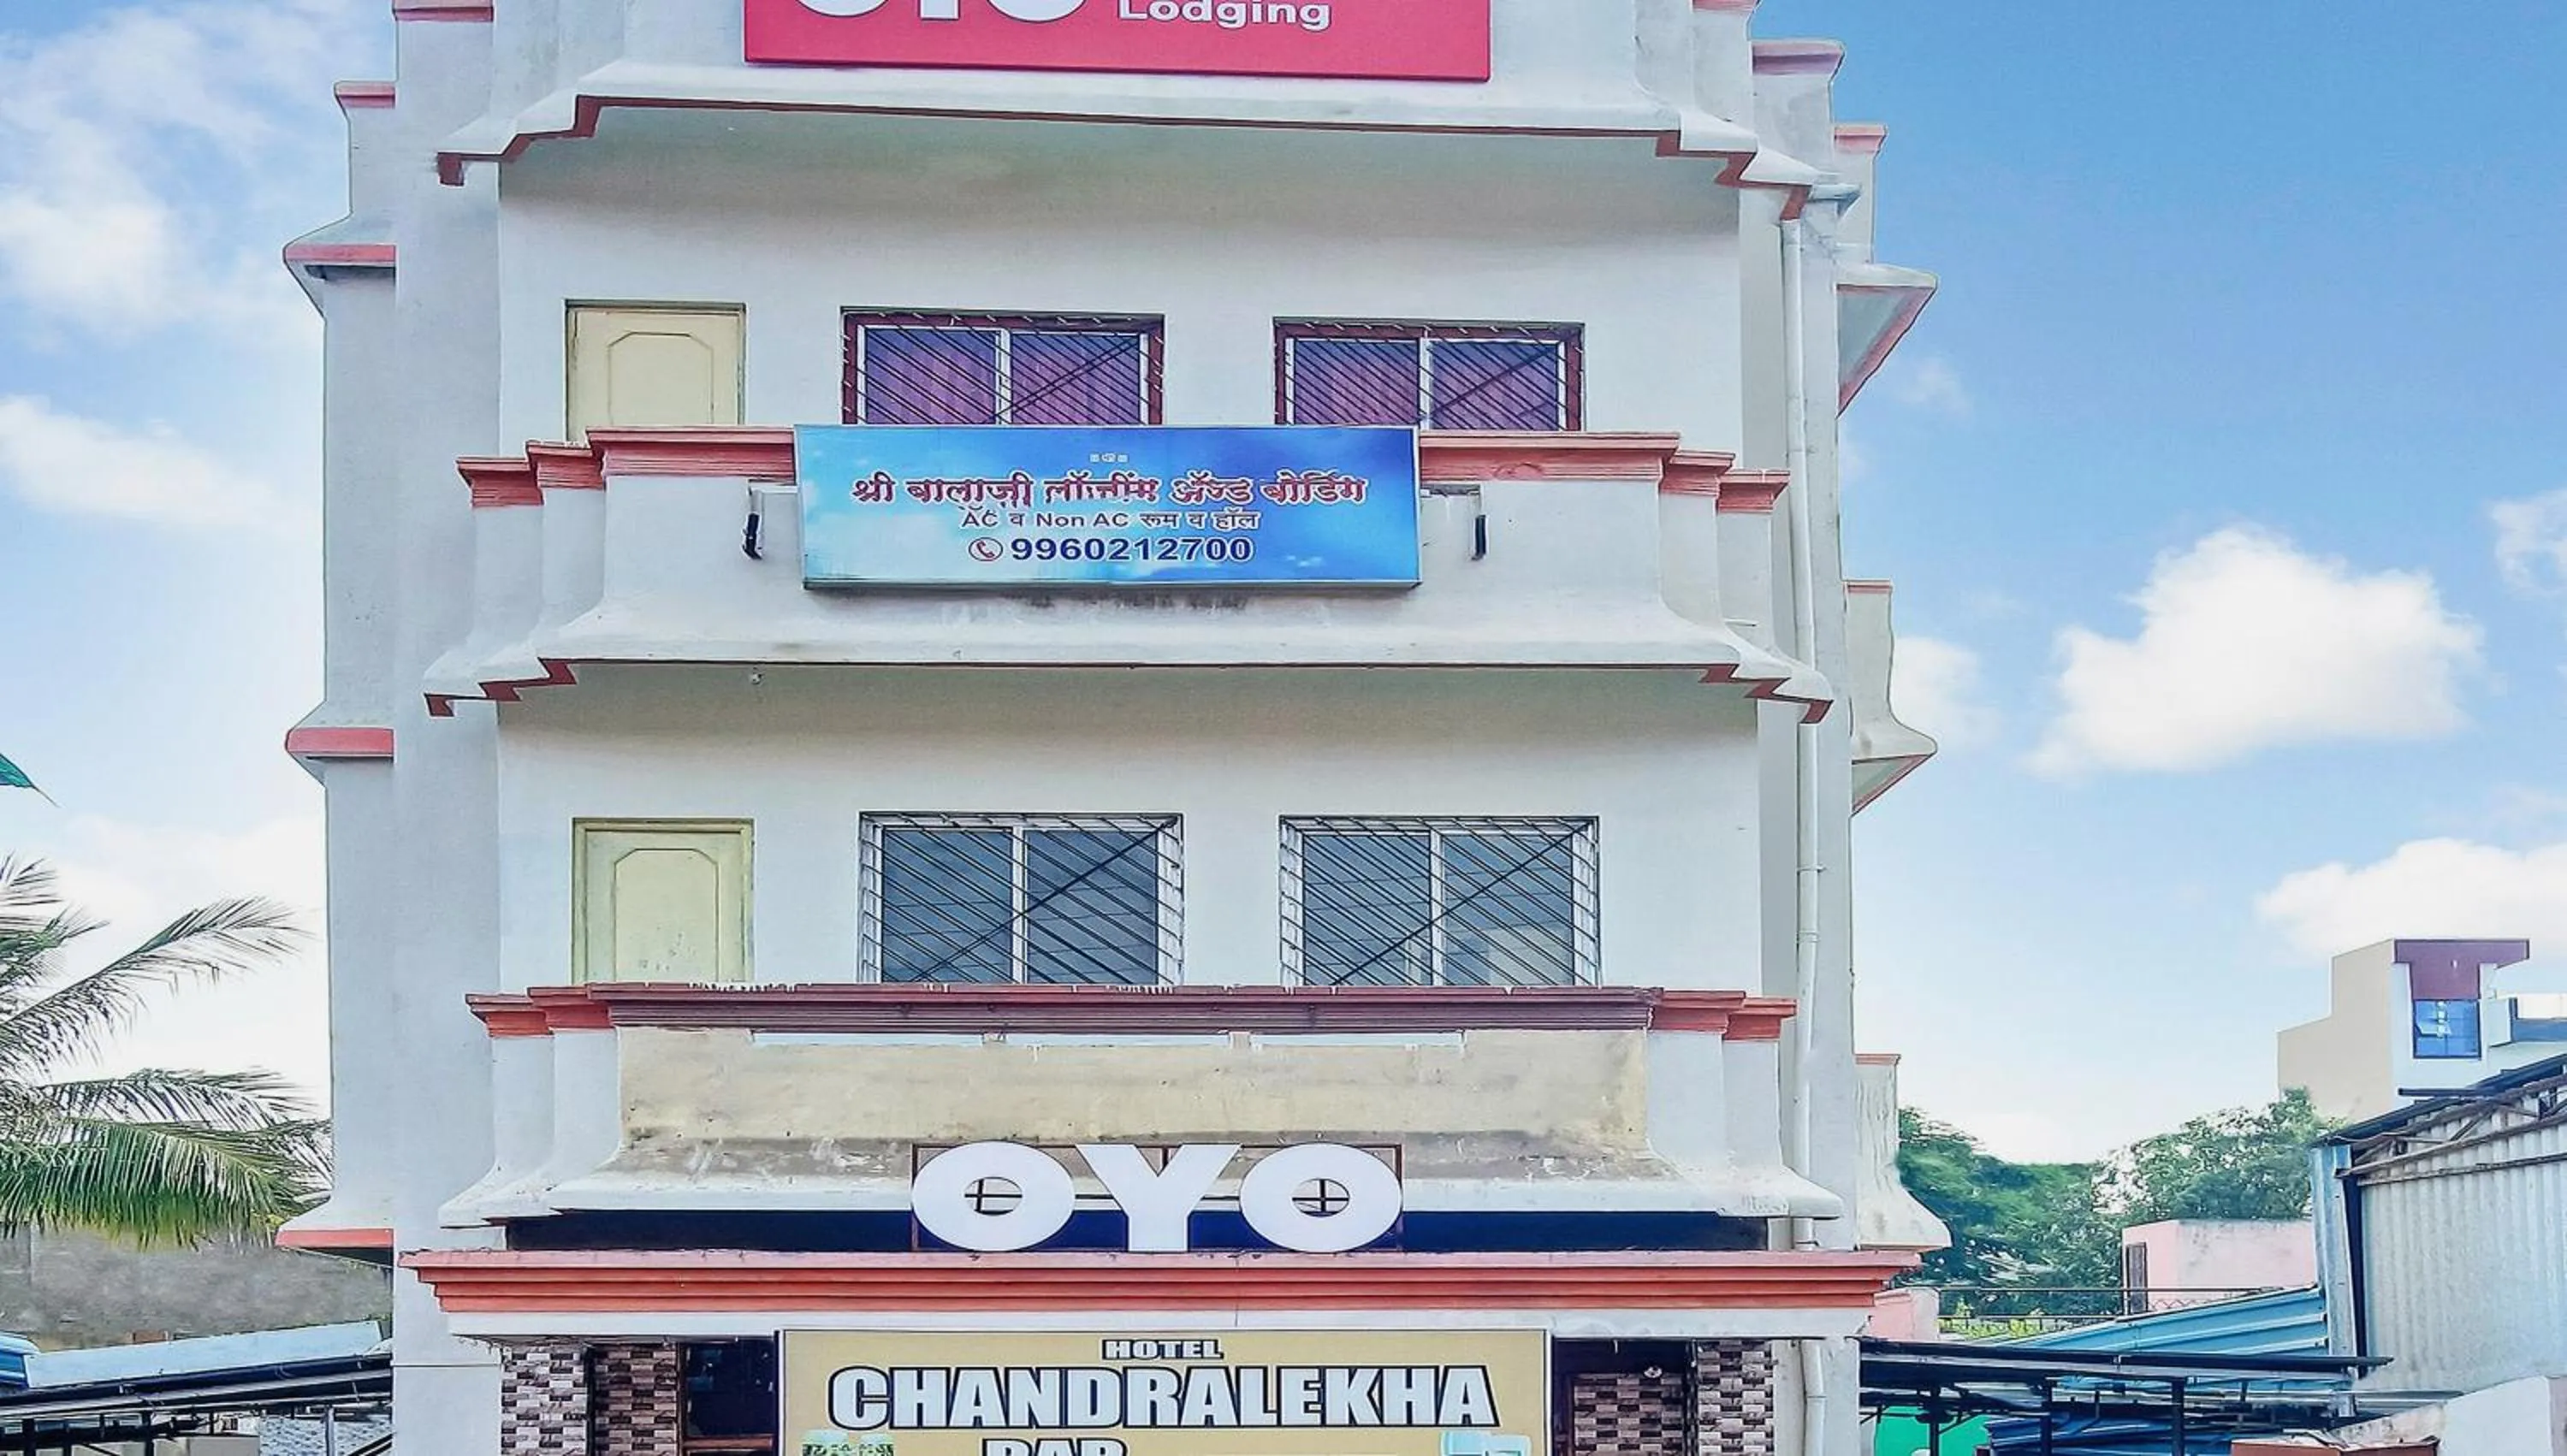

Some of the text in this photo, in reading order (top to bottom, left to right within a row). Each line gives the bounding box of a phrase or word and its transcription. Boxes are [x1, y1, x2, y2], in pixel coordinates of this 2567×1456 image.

[1118, 0, 1331, 31] Lodging
[852, 471, 895, 502] श्री
[1036, 513, 1084, 527] Non
[1093, 513, 1129, 527] AC
[1011, 538, 1251, 560] 9960212700
[910, 1141, 1402, 1252] OYO
[1102, 1340, 1224, 1359] HOTEL
[828, 1366, 1499, 1429] CHANDRALEKHA
